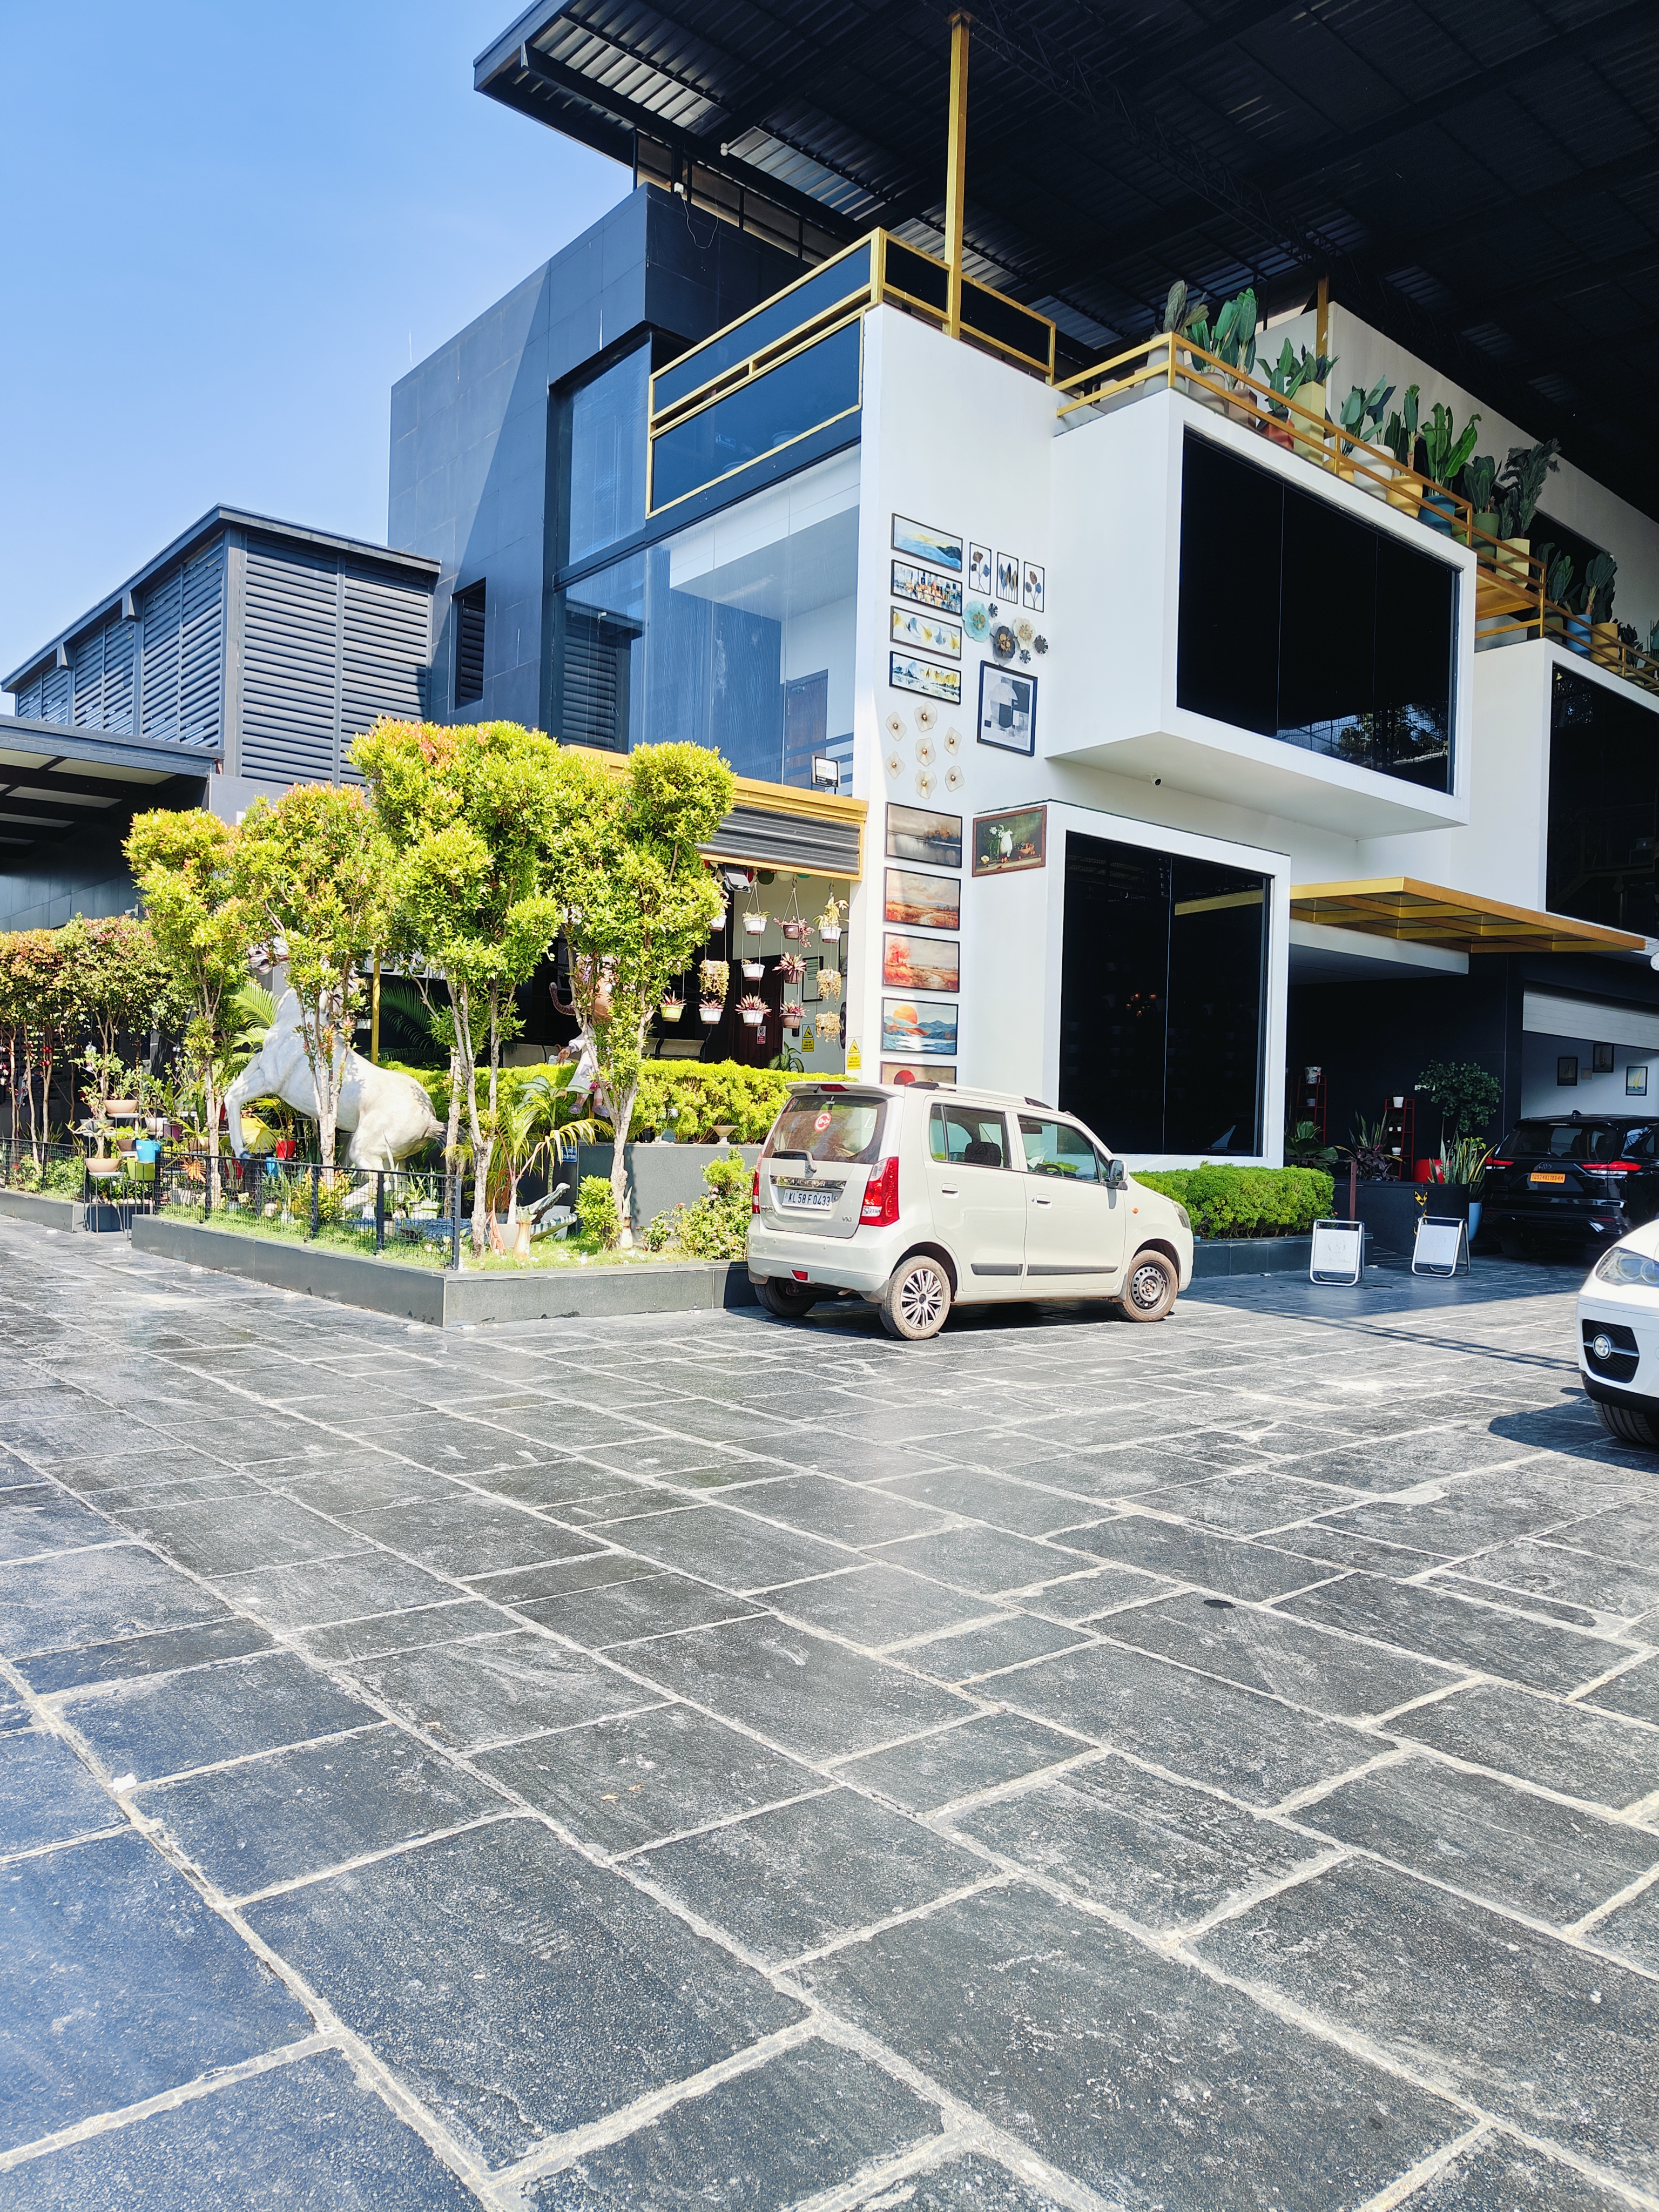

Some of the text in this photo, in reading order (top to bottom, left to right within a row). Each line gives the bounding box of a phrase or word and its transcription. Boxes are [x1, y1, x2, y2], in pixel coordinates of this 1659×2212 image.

[788, 1192, 796, 1203] KL
[798, 1193, 806, 1204] 58
[807, 1194, 812, 1204] F
[813, 1195, 831, 1206] 0433
